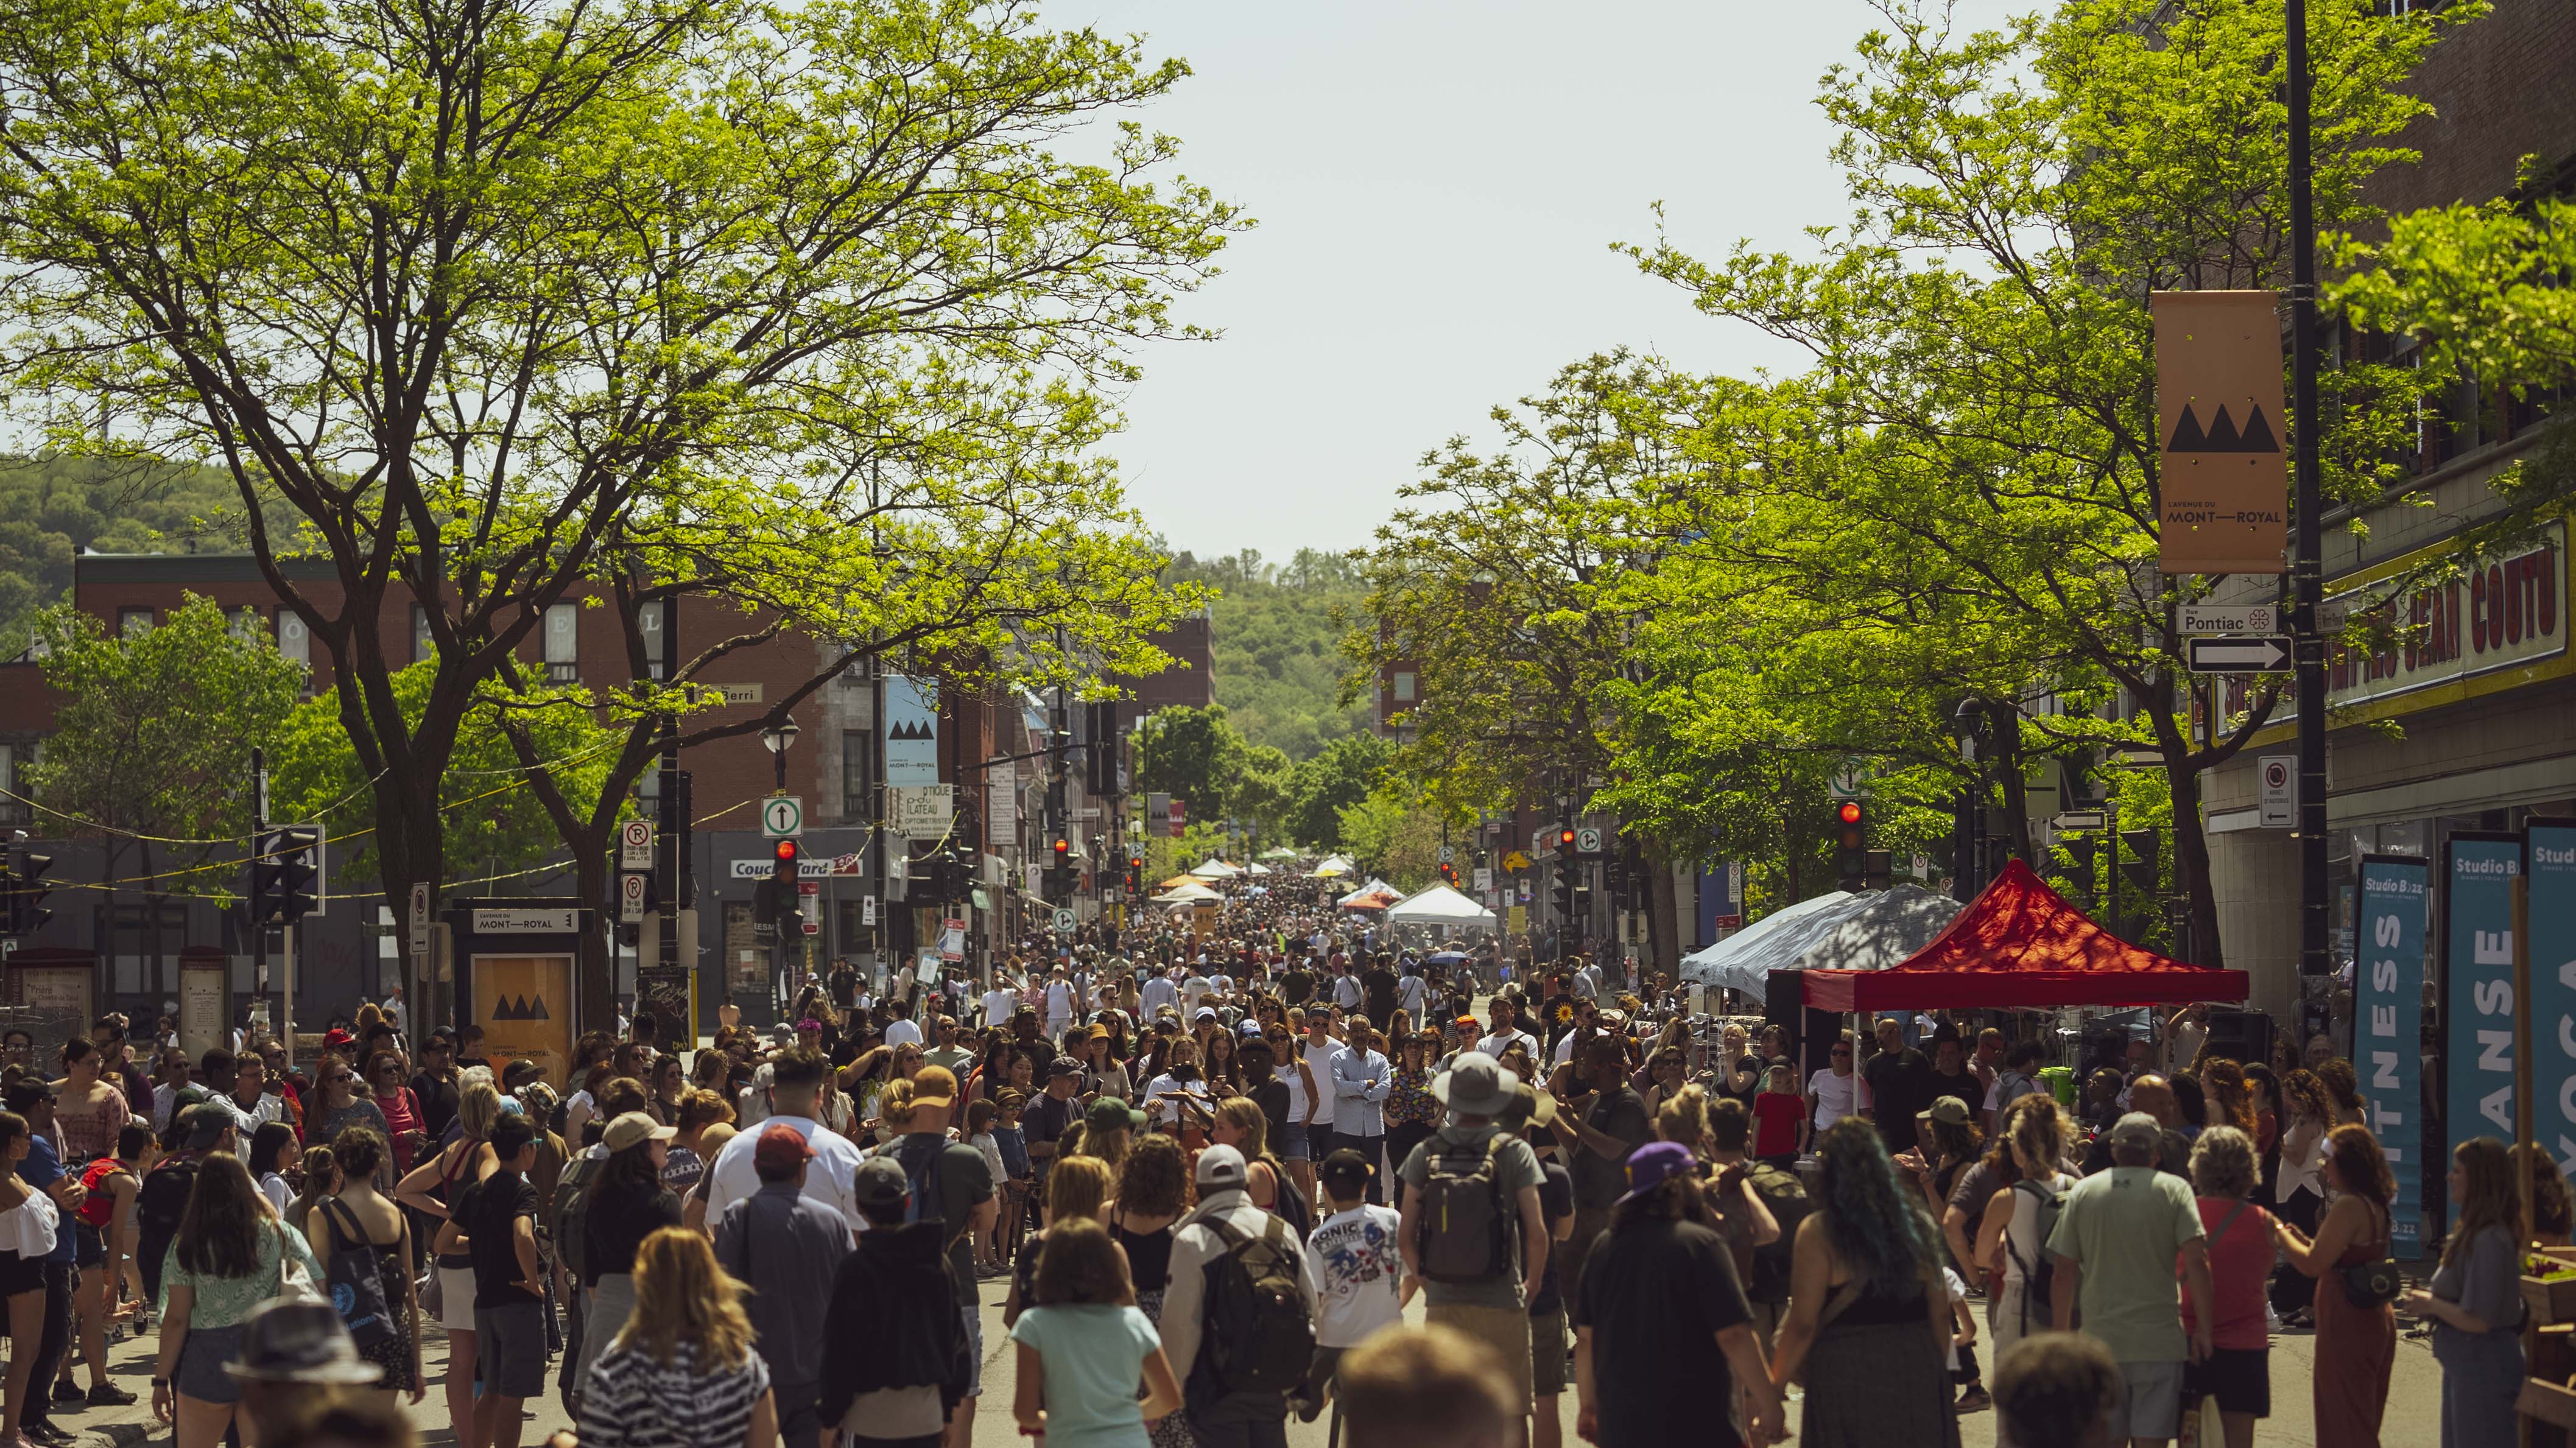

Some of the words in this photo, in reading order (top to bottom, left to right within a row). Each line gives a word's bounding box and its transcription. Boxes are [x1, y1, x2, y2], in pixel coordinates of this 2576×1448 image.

[2471, 546, 2556, 655] COUTU
[2186, 616, 2243, 630] Pontiac
[721, 690, 753, 700] Berri
[2535, 848, 2575, 863] Stud
[2457, 858, 2505, 874] Studio
[2365, 877, 2398, 892] Studio
[2474, 930, 2514, 1134] ANSE
[2372, 915, 2402, 1205] ITNESS
